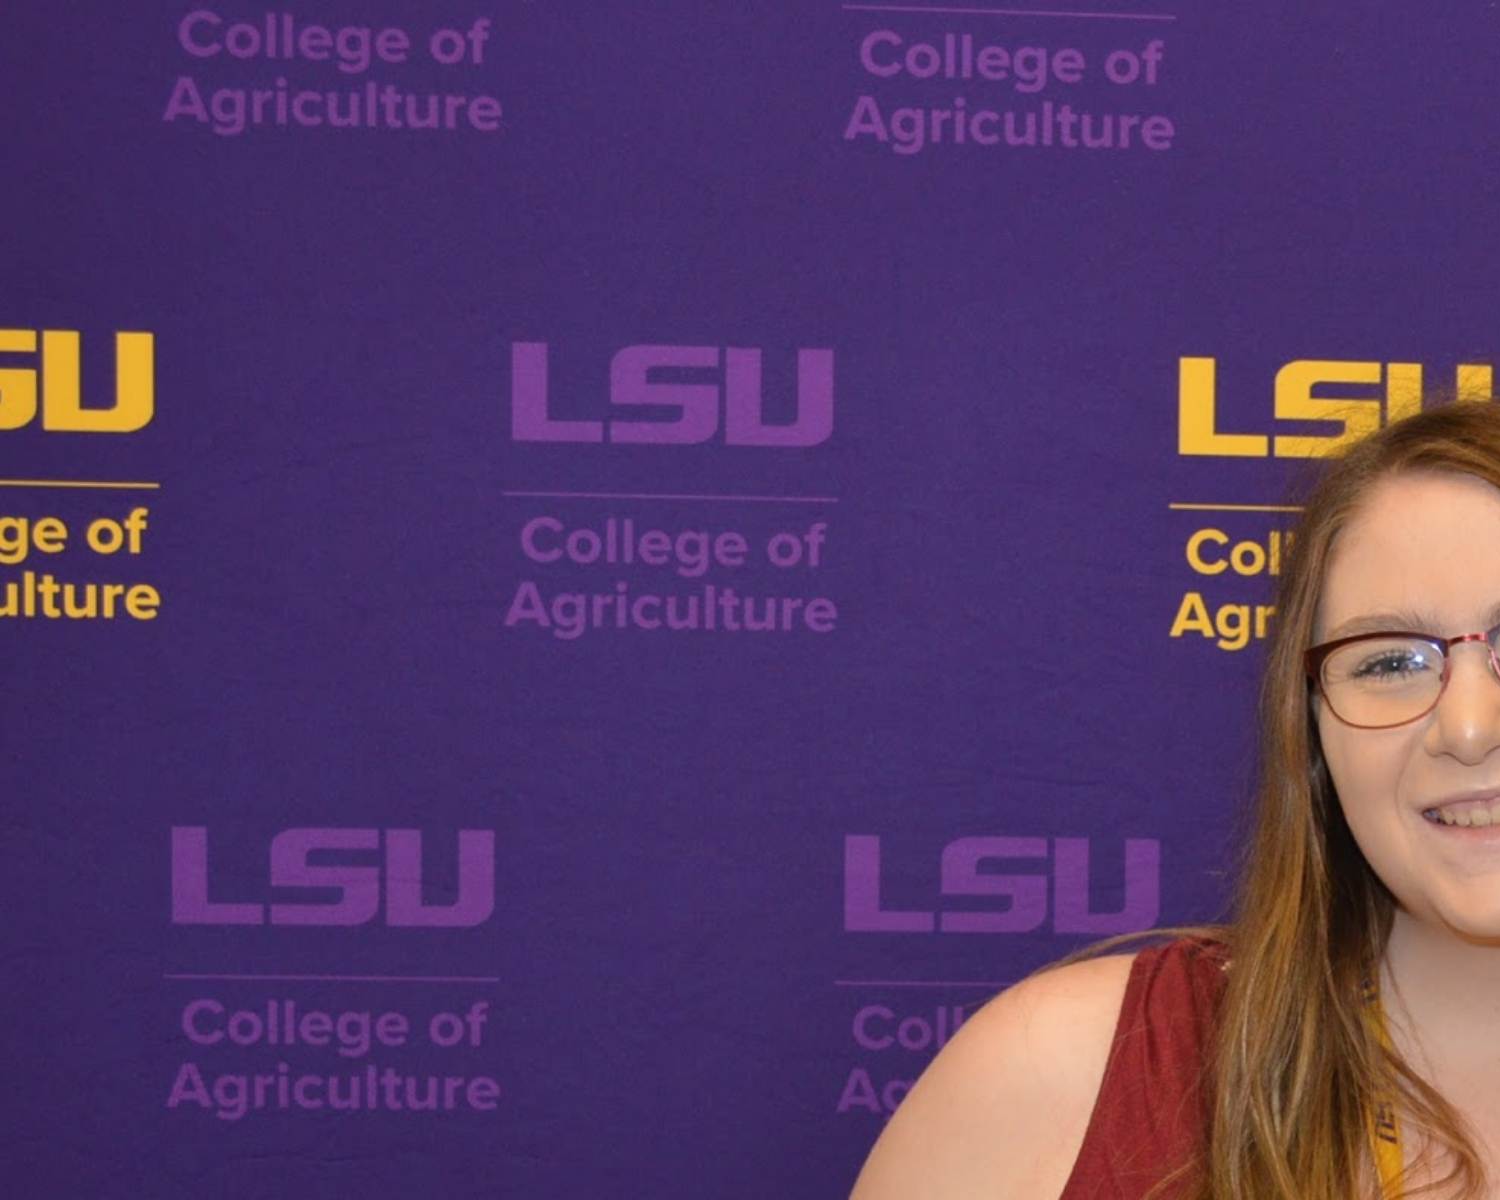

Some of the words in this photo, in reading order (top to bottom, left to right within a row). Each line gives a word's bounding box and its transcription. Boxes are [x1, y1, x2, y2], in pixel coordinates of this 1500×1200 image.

[178, 9, 411, 75] College
[429, 17, 491, 65] of
[860, 29, 1086, 94] College
[1104, 39, 1164, 85] of
[163, 76, 503, 136] Agriculture
[844, 95, 1175, 155] Agriculture
[511, 341, 835, 447] LSU
[86, 507, 148, 554] of
[520, 516, 749, 578] College
[766, 522, 827, 568] of
[504, 581, 838, 640] Agriculture
[170, 826, 496, 928] LSU
[843, 833, 1161, 934] LSU
[181, 998, 409, 1058] College
[429, 1000, 489, 1047] of
[166, 1062, 502, 1121] Agriculture
